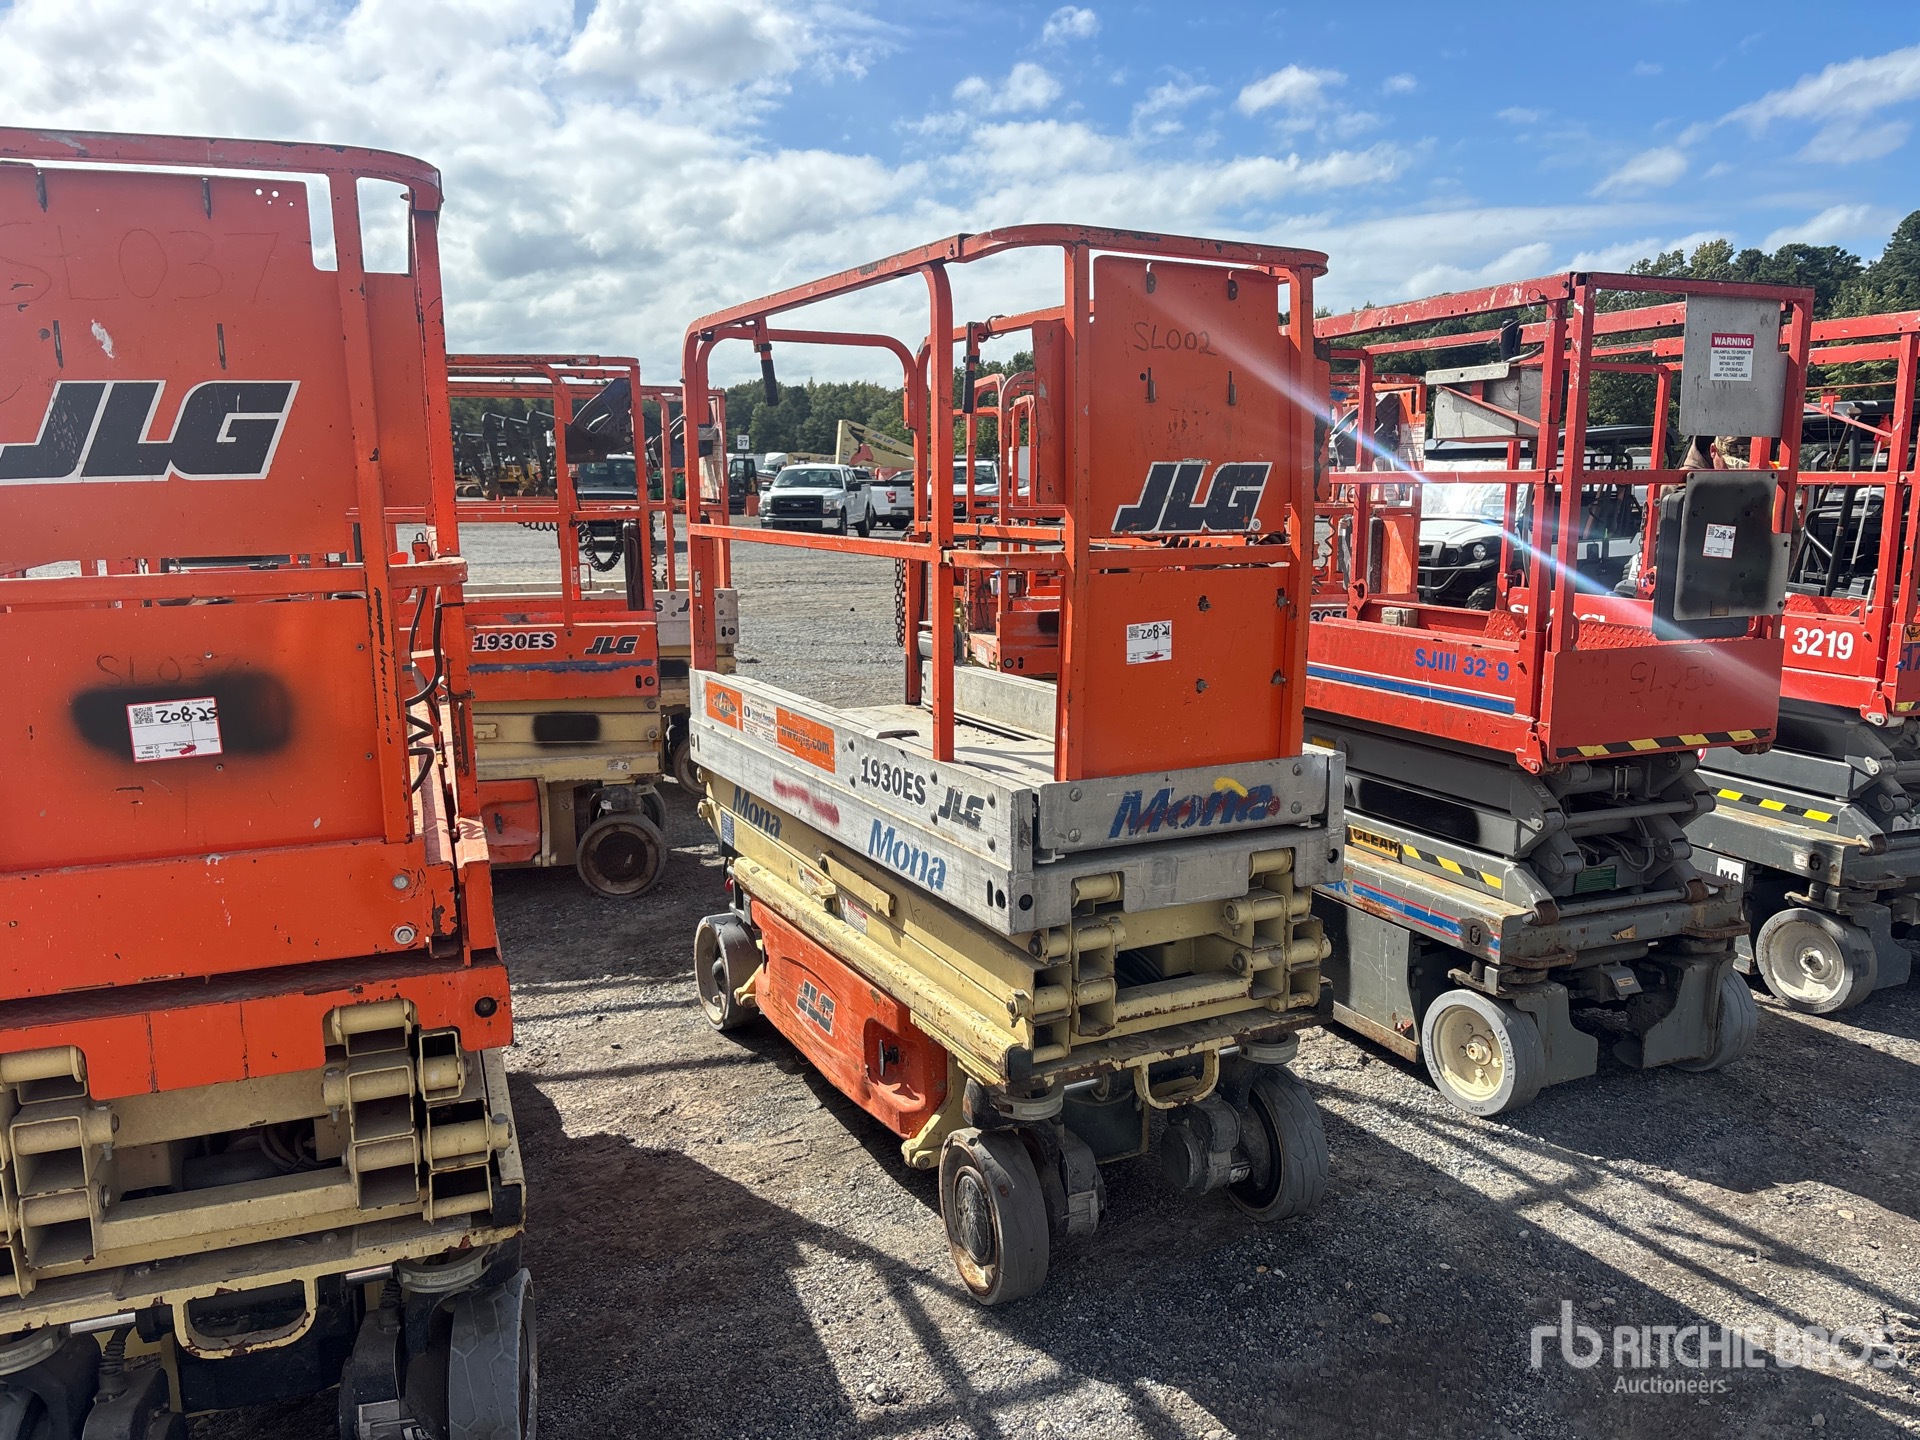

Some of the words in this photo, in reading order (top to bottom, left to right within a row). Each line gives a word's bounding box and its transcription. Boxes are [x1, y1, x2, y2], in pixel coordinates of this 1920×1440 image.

[1133, 322, 1217, 356] SL002
[1714, 336, 1751, 346] WARNING
[0, 380, 300, 486] JLG
[738, 439, 748, 447] 37
[1111, 461, 1273, 535] JLG
[472, 632, 557, 652] 1930ES
[584, 635, 640, 655] JLG
[1792, 627, 1854, 660] 3219
[1463, 656, 1510, 682] 329
[155, 706, 219, 724] 208-25
[860, 756, 928, 808] 1930ES
[732, 786, 783, 840] Mona
[938, 786, 985, 829] JLG
[1108, 783, 1274, 839] Mona
[868, 819, 947, 891] Mona
[1353, 828, 1399, 853] CLEAR
